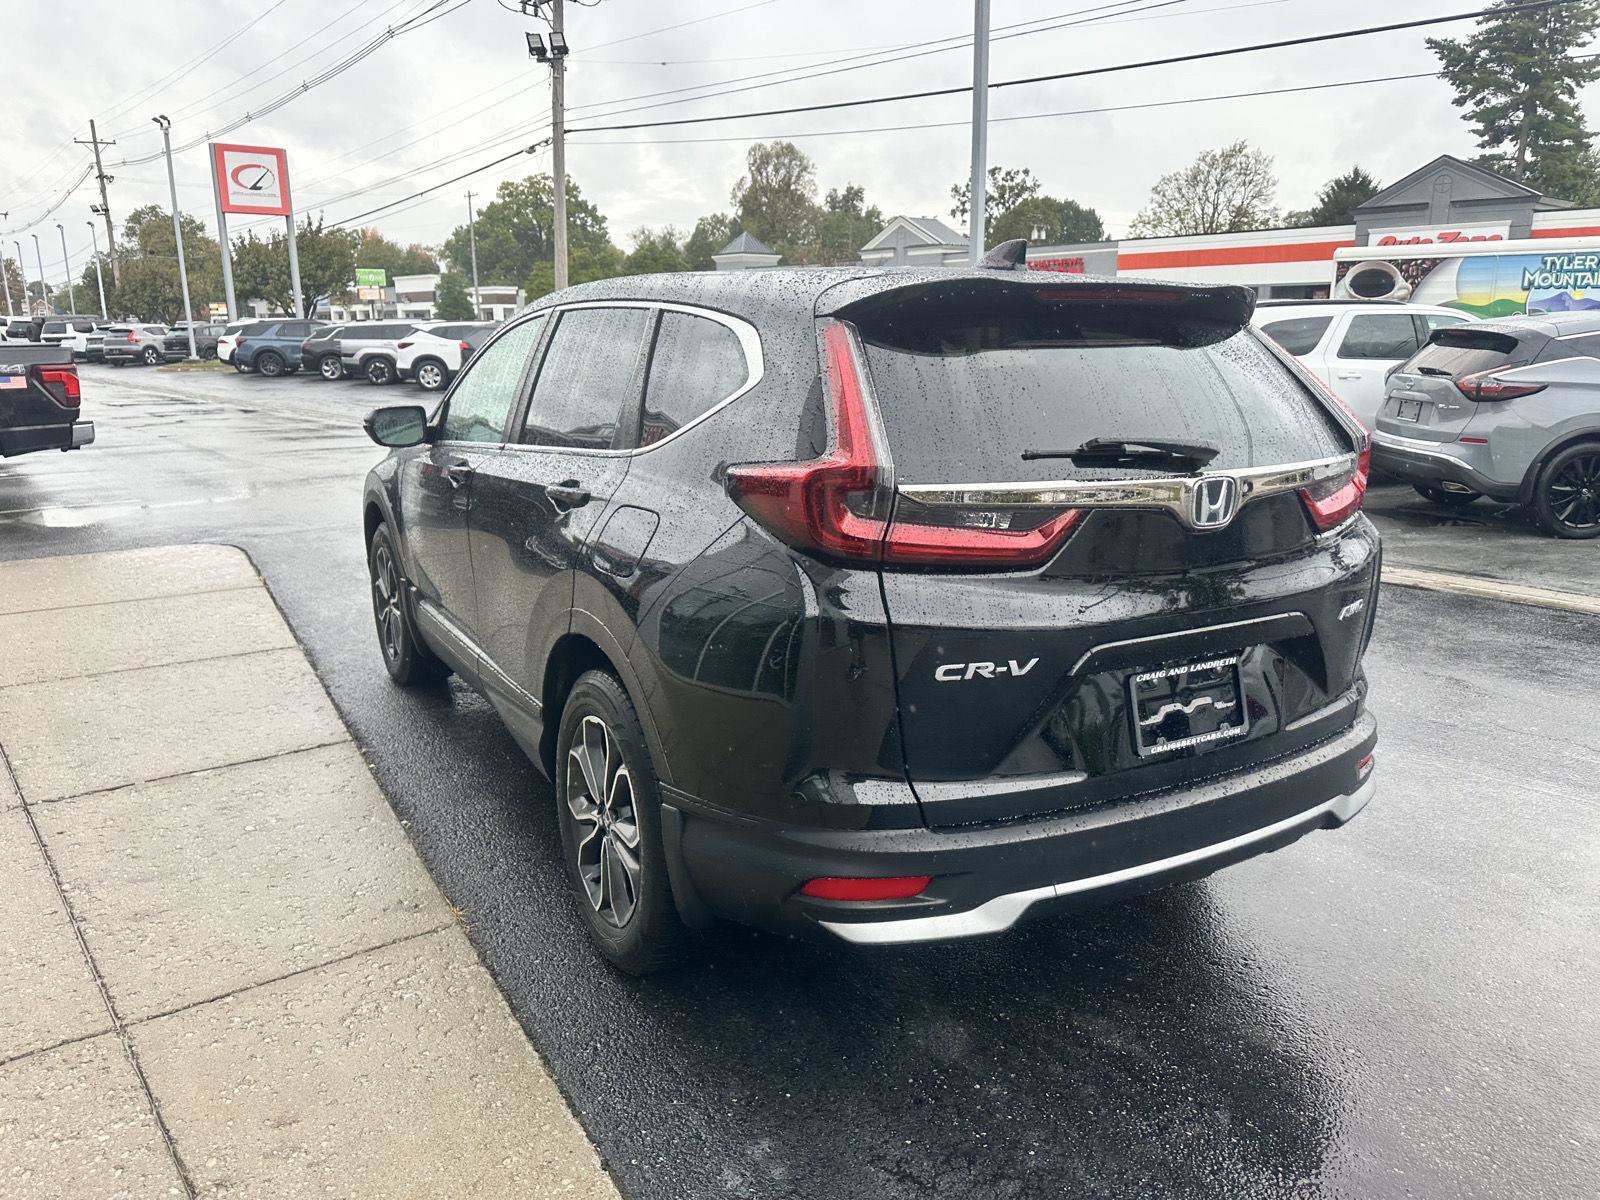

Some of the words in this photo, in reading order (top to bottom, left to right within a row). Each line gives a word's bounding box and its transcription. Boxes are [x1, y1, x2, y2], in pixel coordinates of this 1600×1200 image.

[1543, 254, 1598, 270] TYLER
[1523, 268, 1600, 288] MOUNTAI
[934, 657, 1040, 681] CR-V
[1136, 670, 1166, 682] CRAIG
[1168, 664, 1188, 677] AND
[1190, 656, 1237, 672] LANDRETH
[1150, 727, 1241, 754] CRAIGSBESTCARS.COM
